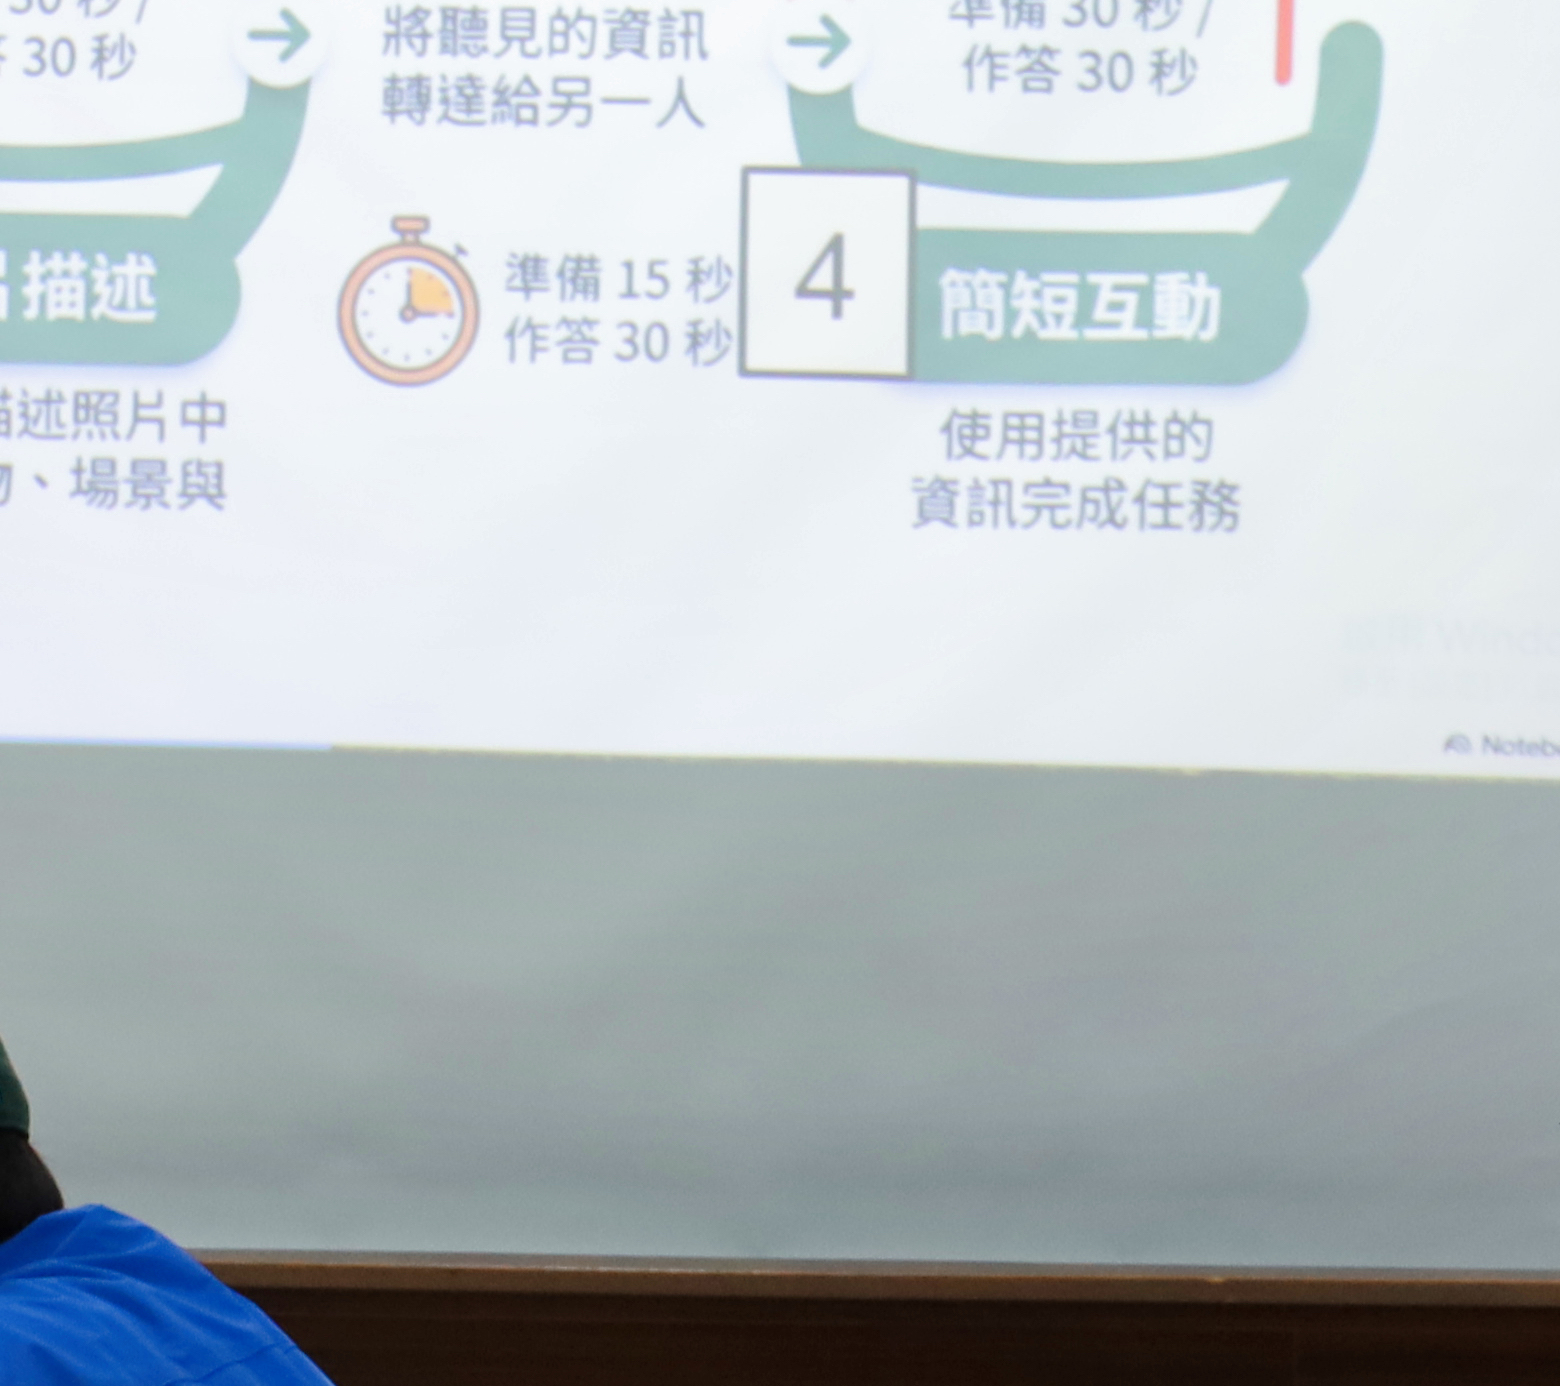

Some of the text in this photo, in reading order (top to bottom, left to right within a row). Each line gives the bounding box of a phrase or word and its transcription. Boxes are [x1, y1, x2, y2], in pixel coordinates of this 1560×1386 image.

[22, 35, 77, 78] 30
[382, 4, 709, 61] 將聽見的資訊
[1076, 49, 1135, 94] 30
[381, 72, 706, 129] 轉達給另一人
[618, 258, 671, 301] 15
[794, 232, 855, 320] 4
[939, 268, 1221, 343] 簡短互動
[614, 320, 671, 364] 30
[939, 408, 1214, 463] 使用提供的
[912, 475, 1240, 534] 資訊完成任務
